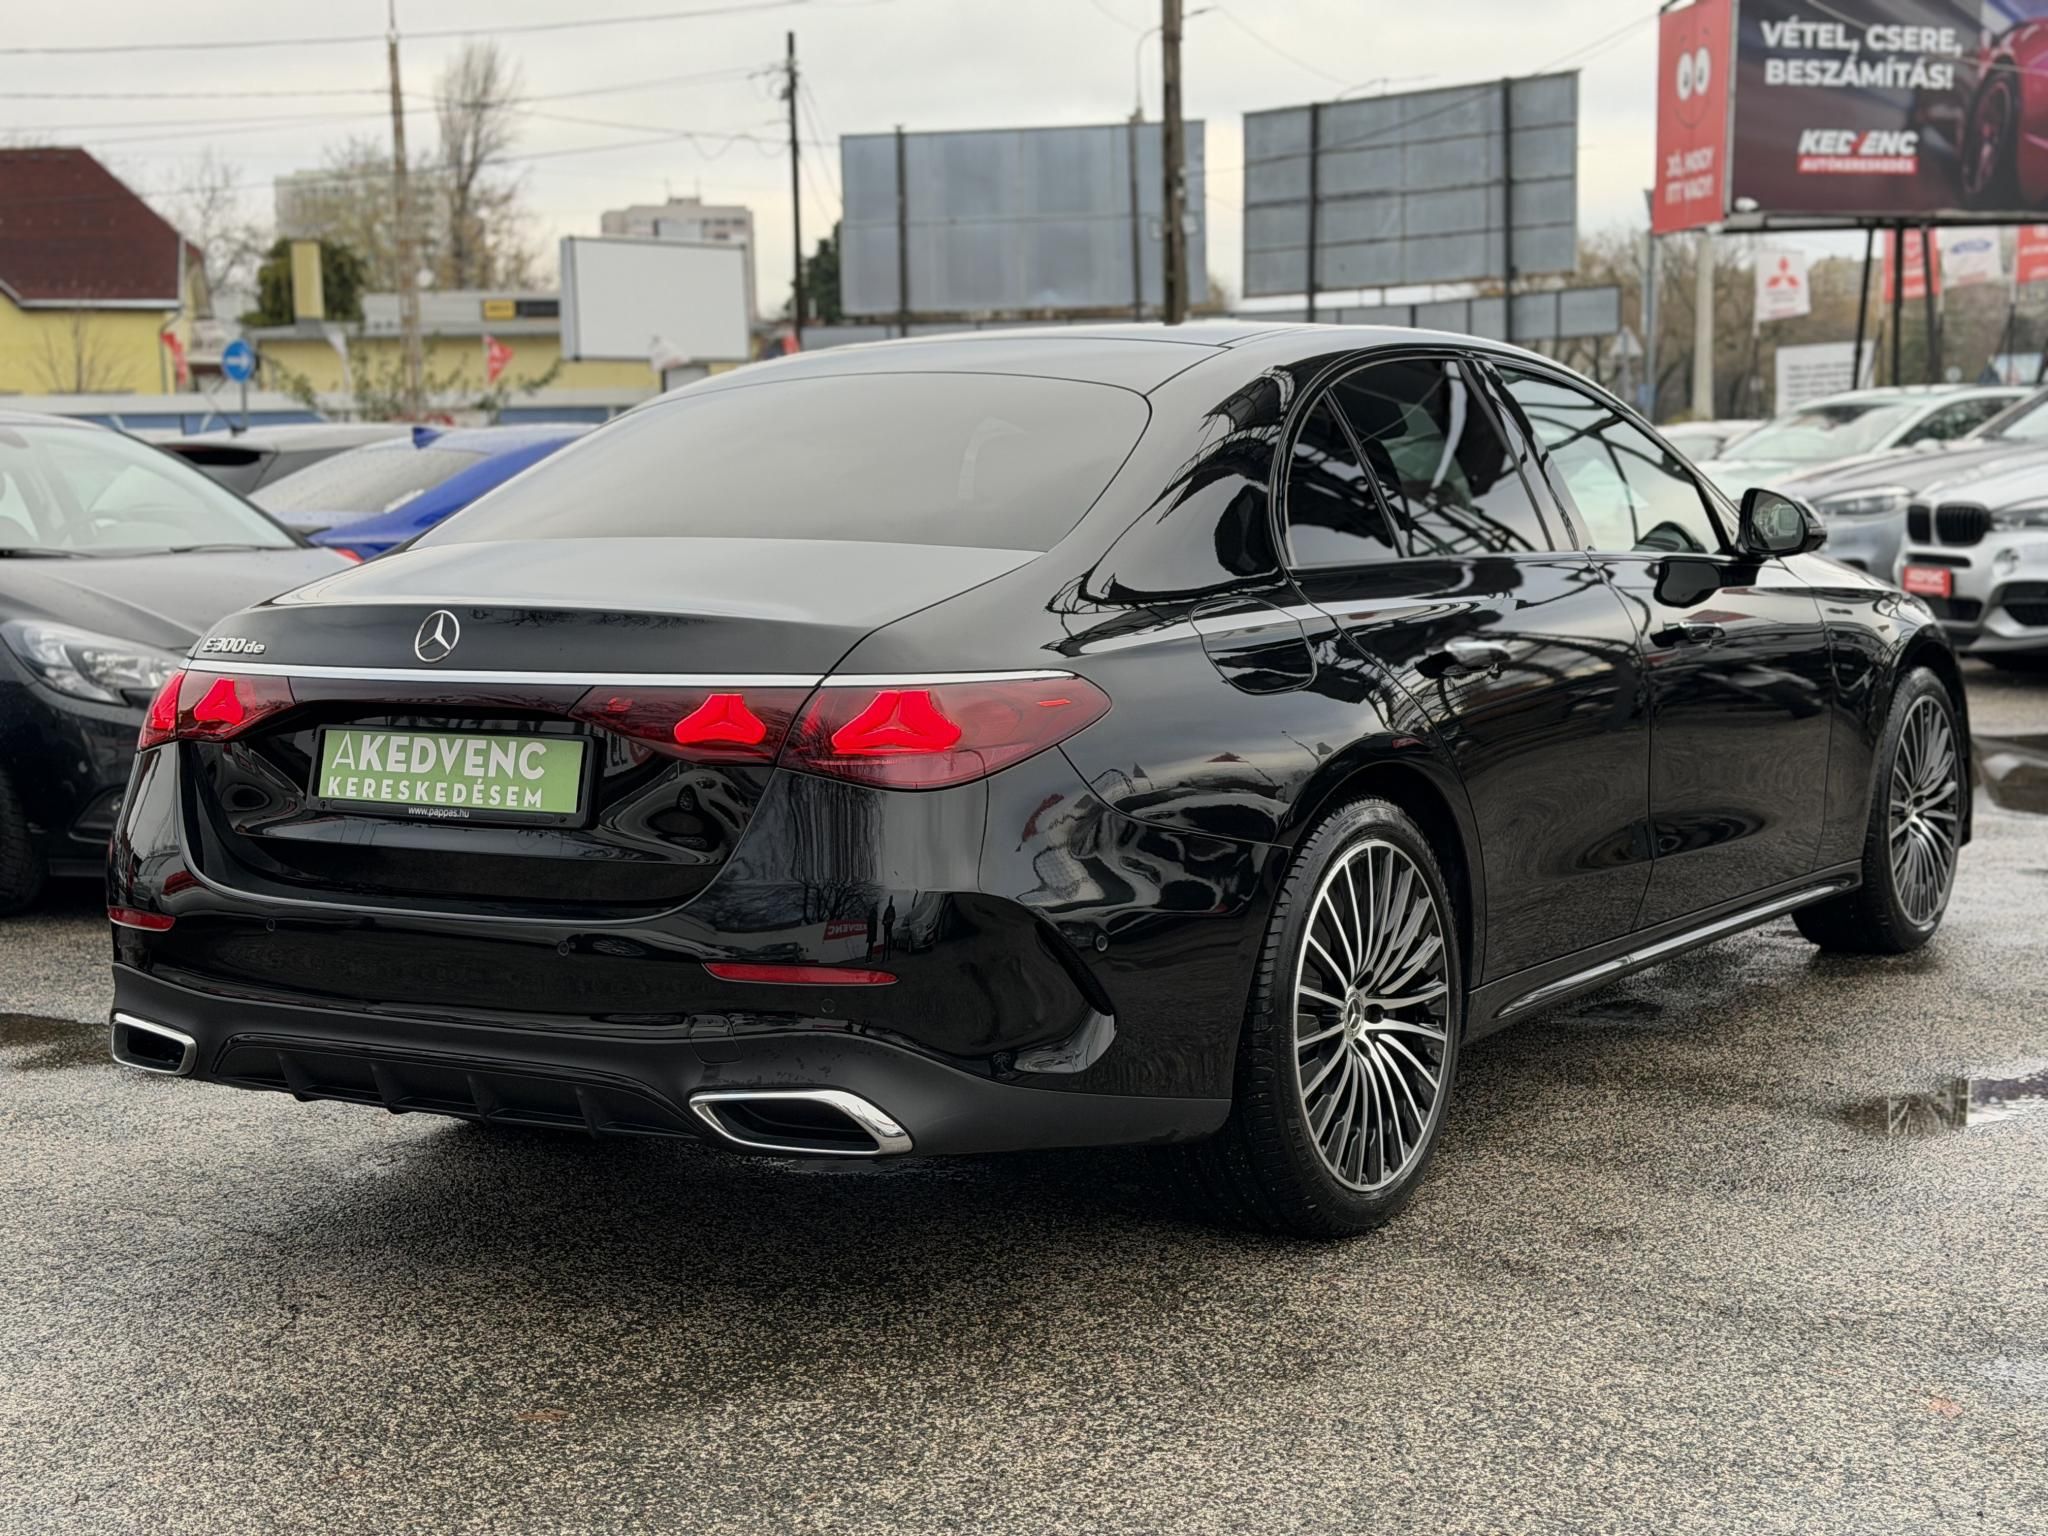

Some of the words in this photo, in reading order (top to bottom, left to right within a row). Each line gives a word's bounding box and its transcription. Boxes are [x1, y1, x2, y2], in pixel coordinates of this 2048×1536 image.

[1761, 15, 1860, 53] VÉTEL,
[1866, 24, 1964, 57] CSERE,
[1765, 54, 1956, 90] BESZÁMÍTÁS!
[202, 637, 266, 655] E300de
[327, 776, 542, 809] KERESKEDÉSEM
[408, 805, 470, 818] www.pappas.hu
